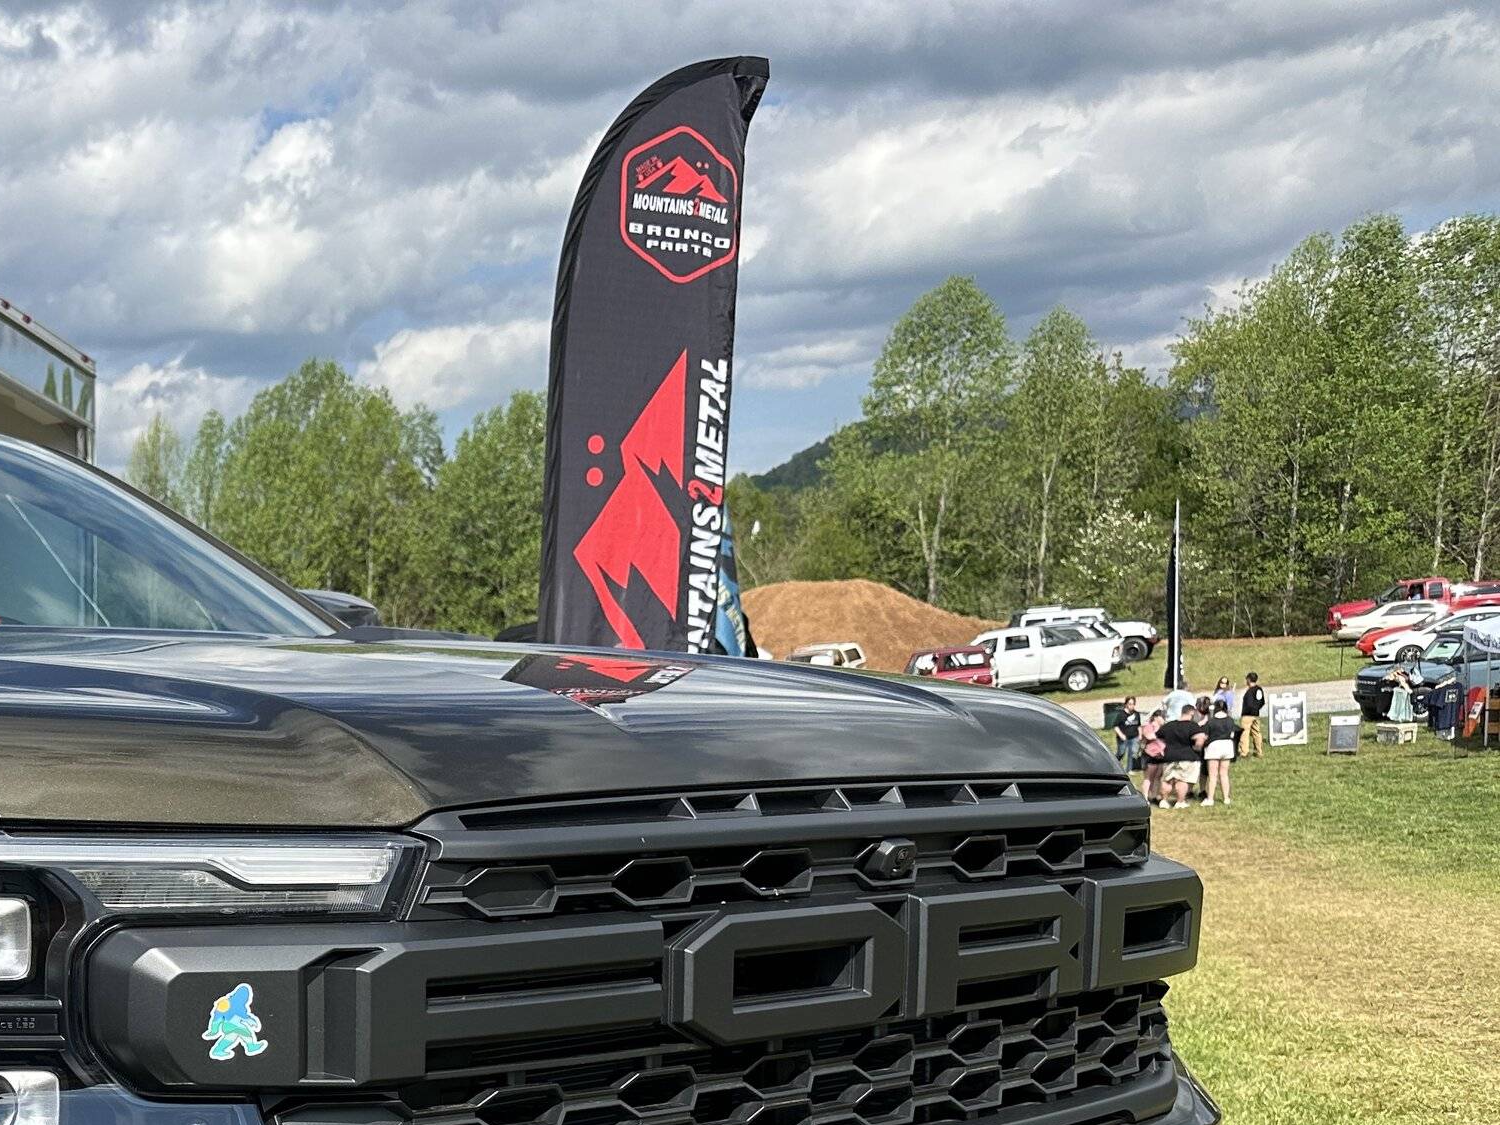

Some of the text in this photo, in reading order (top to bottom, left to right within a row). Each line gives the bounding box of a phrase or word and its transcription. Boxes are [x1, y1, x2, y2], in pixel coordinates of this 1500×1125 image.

[632, 193, 728, 225] MOUNTAINS2METAL
[628, 222, 731, 249] BRONCO
[646, 239, 712, 258] PARTS
[352, 869, 1203, 1087] FORD
[16, 1021, 35, 1029] LED
